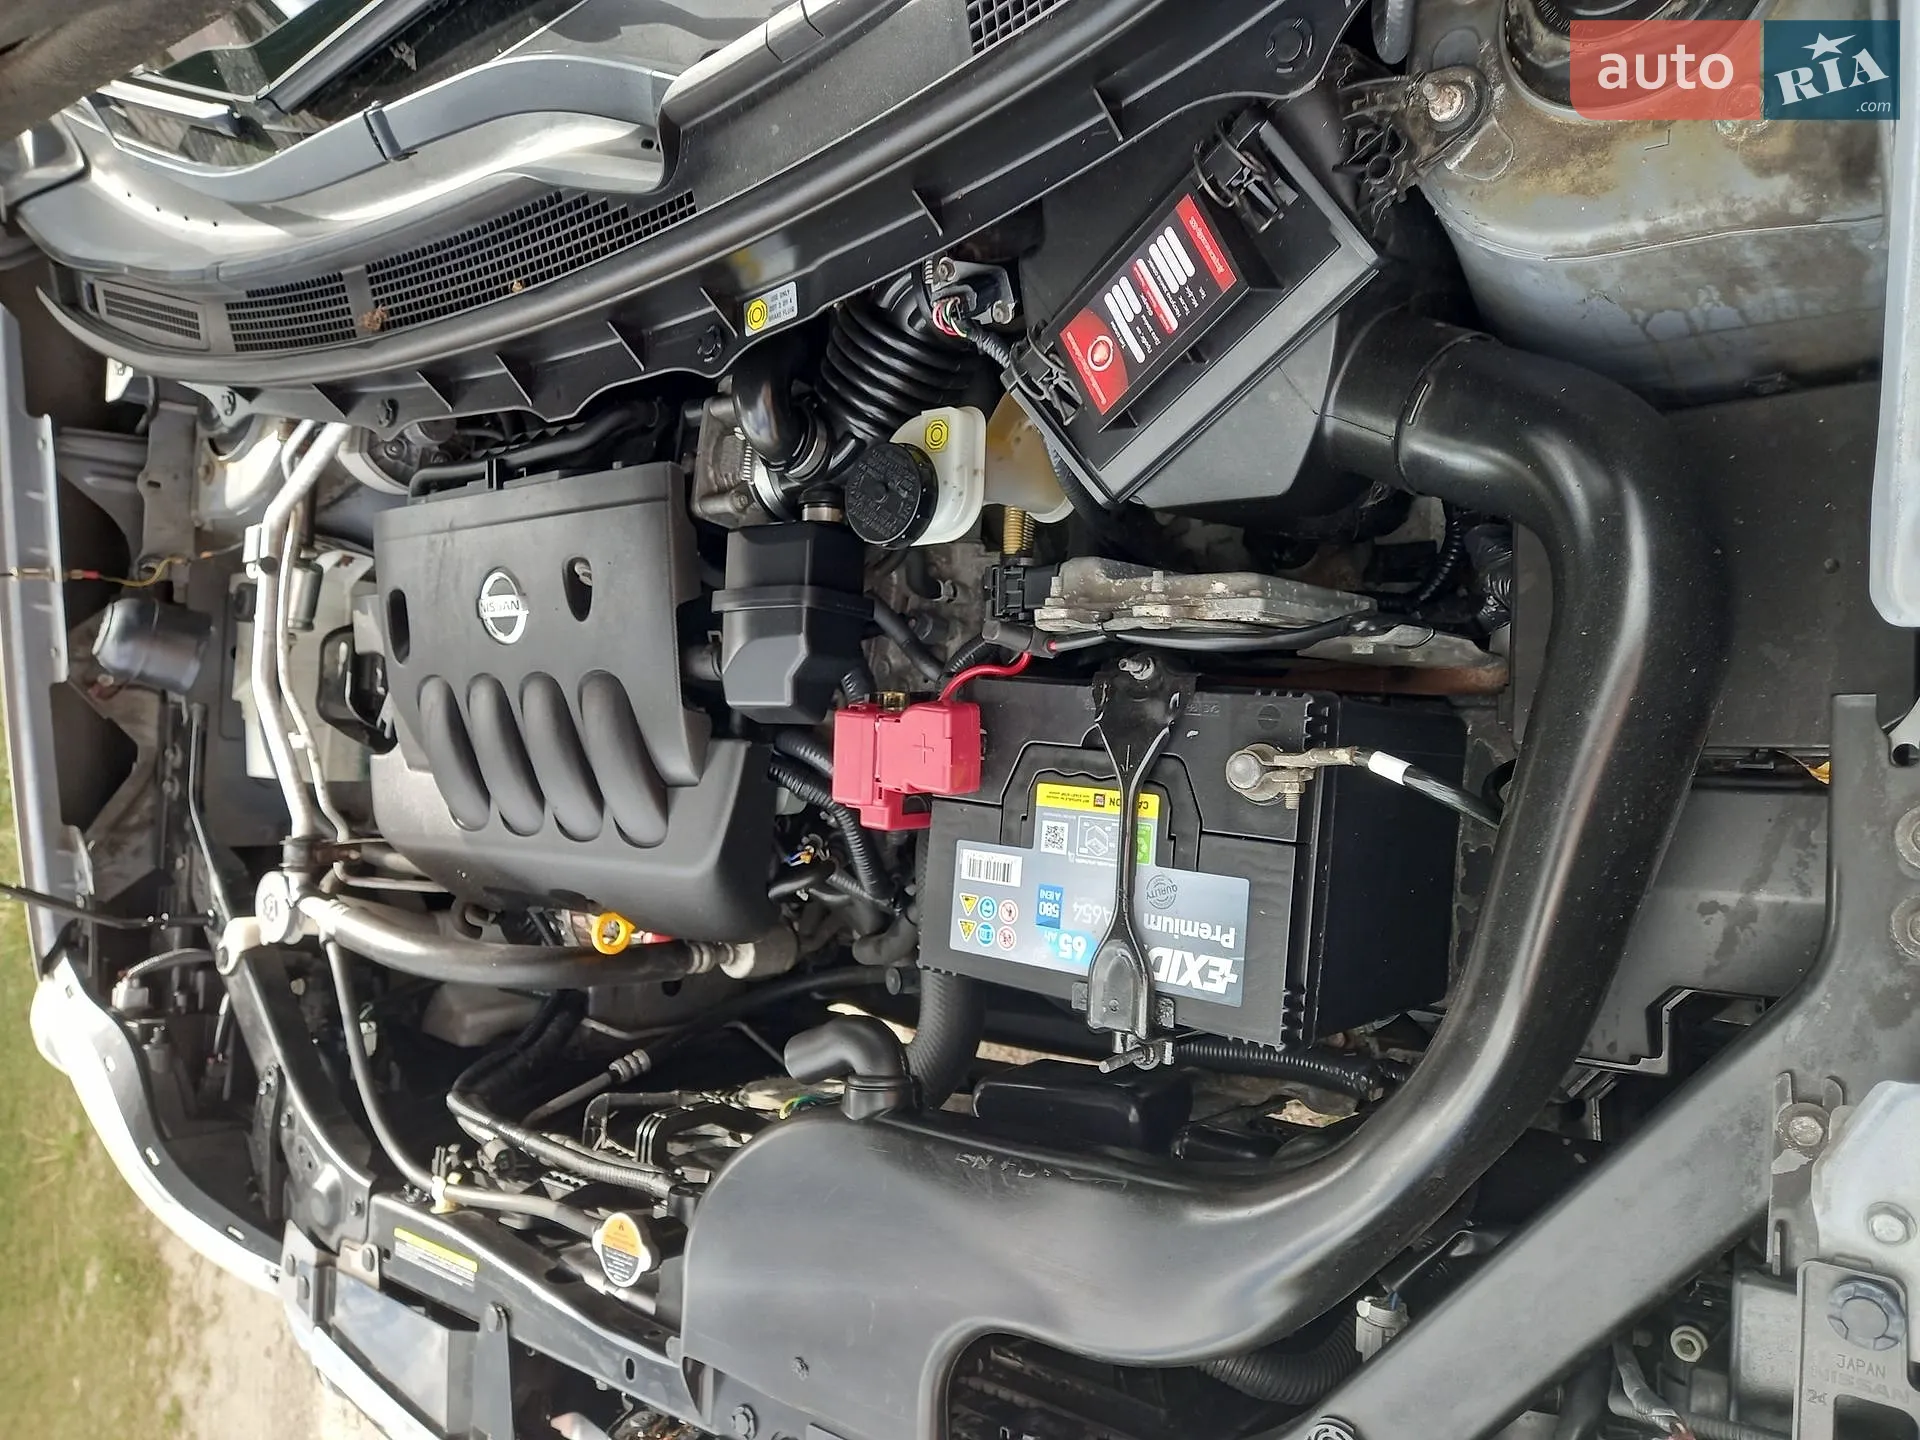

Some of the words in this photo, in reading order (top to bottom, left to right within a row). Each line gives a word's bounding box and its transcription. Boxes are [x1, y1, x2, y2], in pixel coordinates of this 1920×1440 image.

[1109, 797, 1149, 810] CAON
[1145, 884, 1178, 901] QUALITY
[1039, 901, 1060, 918] 580
[1143, 912, 1236, 949] Premium
[1057, 933, 1087, 961] 65
[1143, 944, 1238, 994] EXID
[1836, 1353, 1887, 1379] JAPAN
